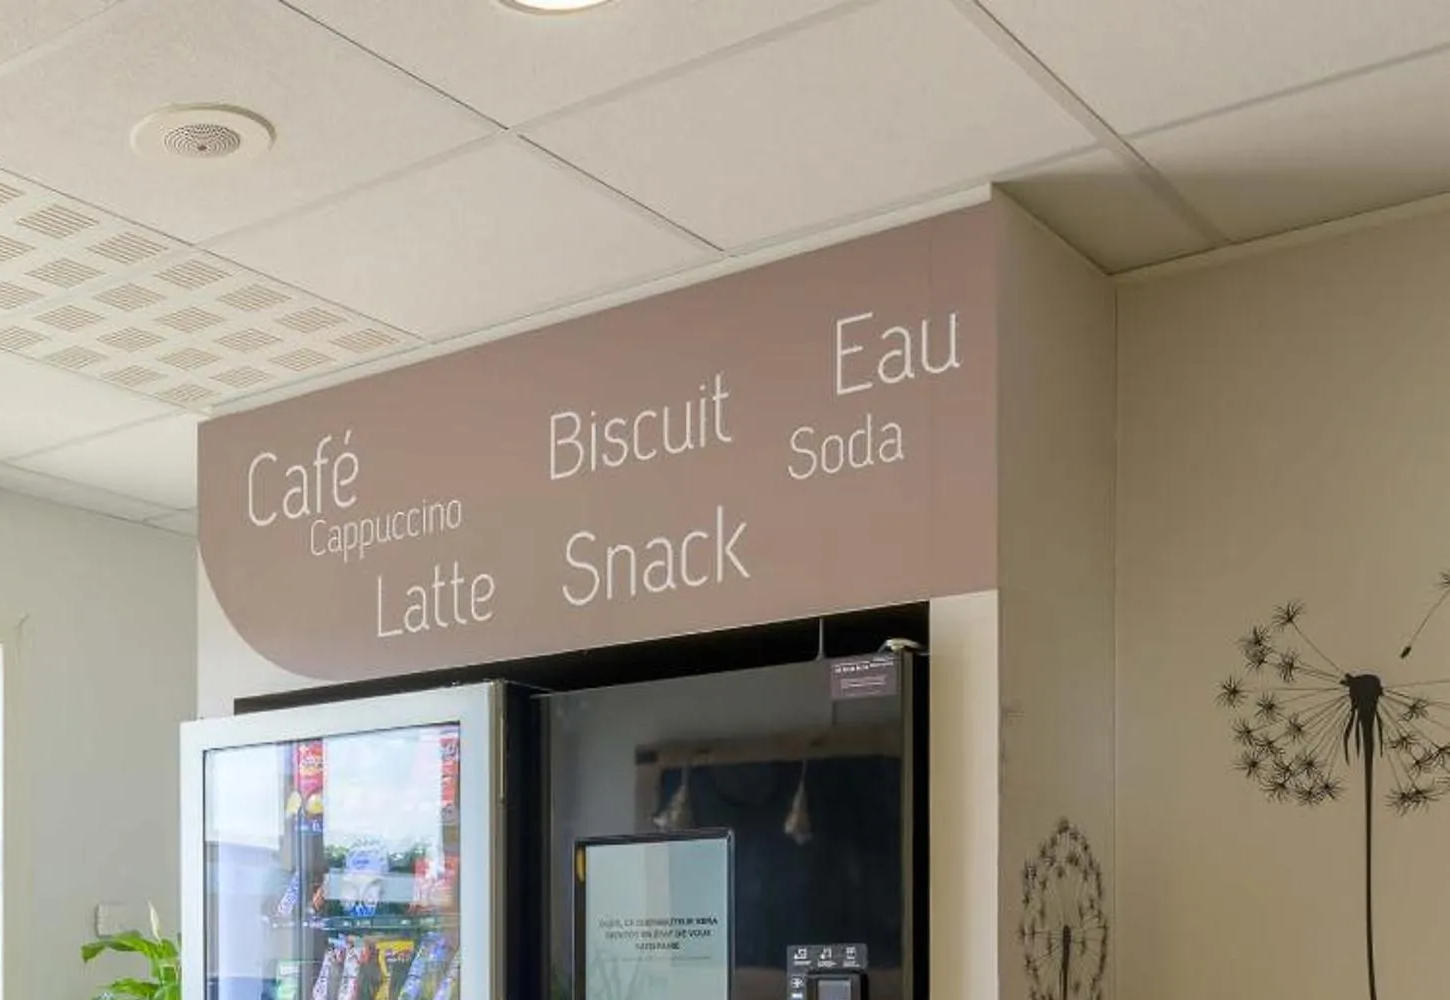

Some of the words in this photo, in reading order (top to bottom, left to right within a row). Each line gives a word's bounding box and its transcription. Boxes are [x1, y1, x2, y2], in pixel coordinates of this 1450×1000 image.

[835, 310, 963, 396] Eau
[550, 372, 734, 481] Biscuit
[787, 412, 906, 481] Soda
[247, 428, 361, 529] Café
[310, 495, 463, 564] Cappuccino
[562, 505, 751, 608] Snack
[375, 562, 498, 639] Latte
